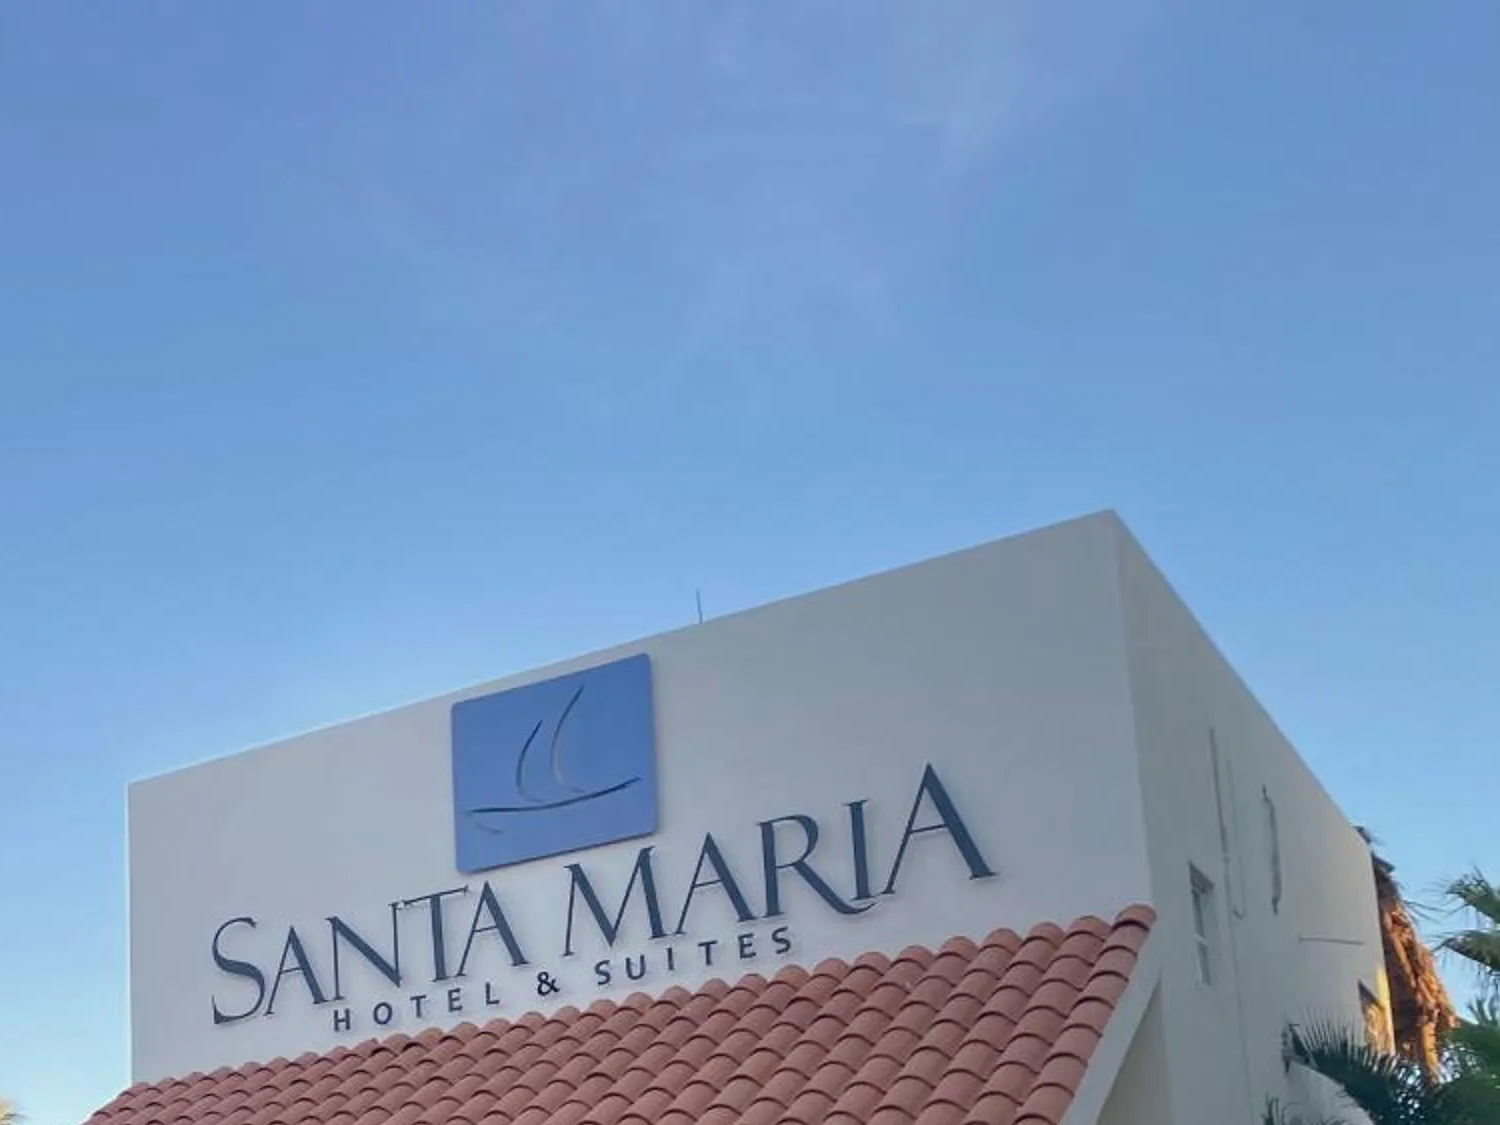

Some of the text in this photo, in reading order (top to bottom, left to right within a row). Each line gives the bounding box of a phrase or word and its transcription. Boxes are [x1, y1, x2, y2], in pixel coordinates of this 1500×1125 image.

[211, 762, 1000, 1026] SANTA MARIA
[333, 926, 793, 1033] HOTEL & SUITES
